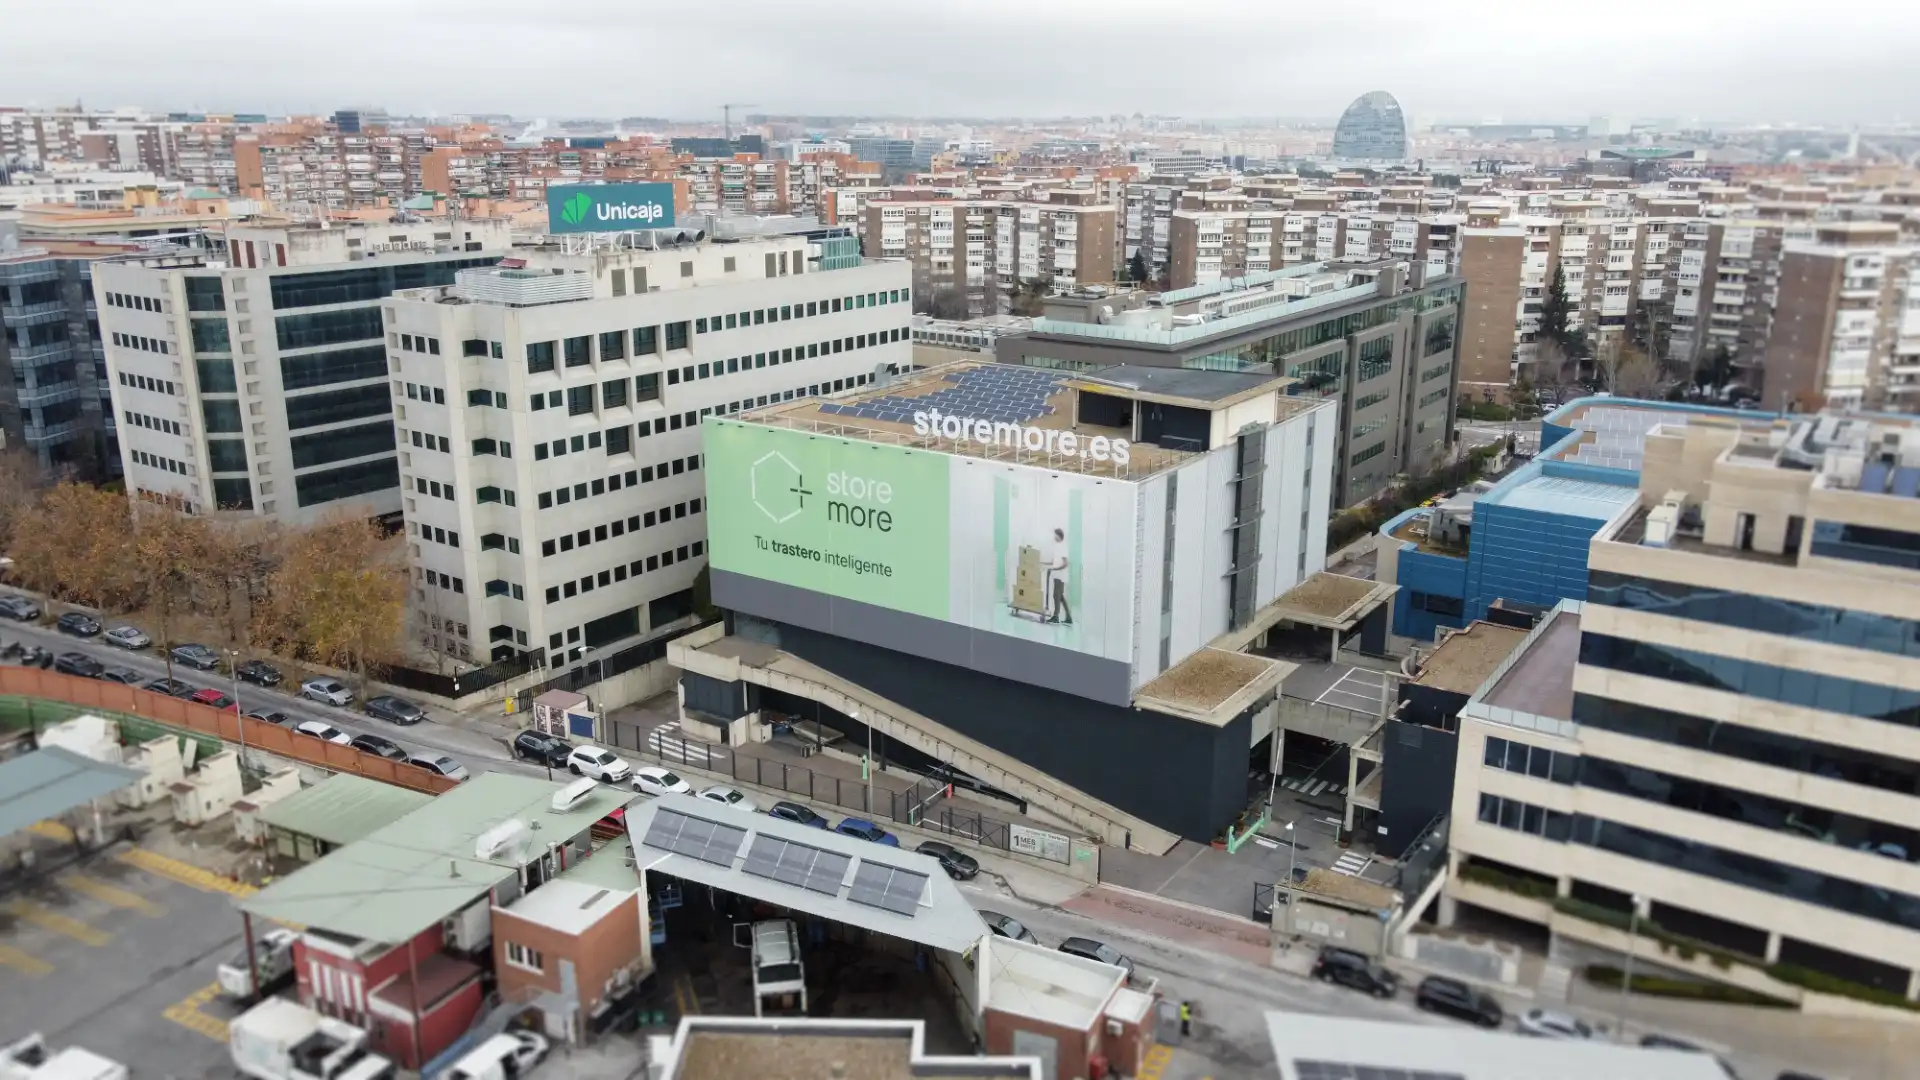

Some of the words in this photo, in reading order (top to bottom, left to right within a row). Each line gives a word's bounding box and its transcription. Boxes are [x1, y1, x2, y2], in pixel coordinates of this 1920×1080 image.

[597, 200, 663, 223] Unicaja
[913, 408, 1130, 464] storemore.es
[827, 469, 892, 504] store
[828, 500, 892, 532] more
[754, 535, 768, 551] Tu
[772, 539, 821, 562] trastero
[824, 550, 893, 577] inteligente
[1013, 835, 1019, 847] 1
[1020, 836, 1036, 846] MES
